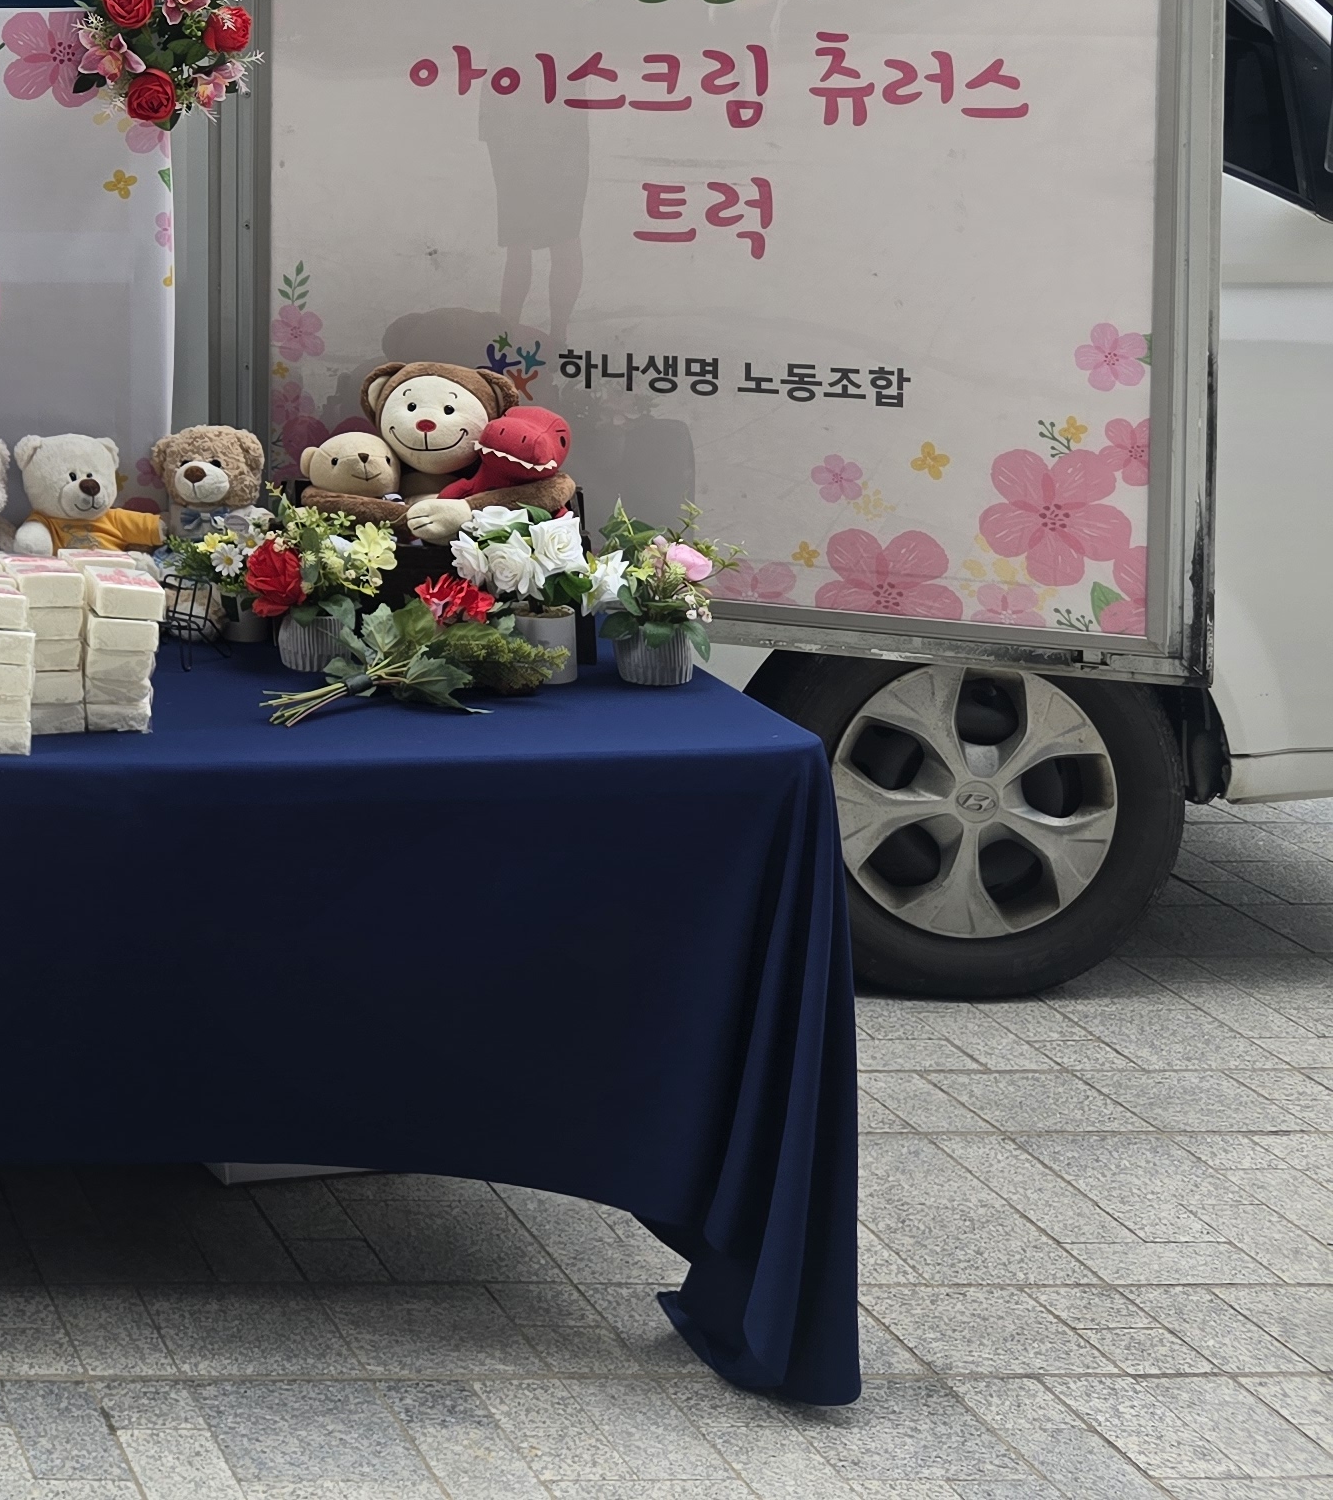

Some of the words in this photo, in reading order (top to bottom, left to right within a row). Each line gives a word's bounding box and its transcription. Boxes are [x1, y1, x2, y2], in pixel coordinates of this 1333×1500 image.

[409, 43, 770, 129] 아이스크림
[808, 31, 1030, 127] 츄러스
[632, 176, 775, 260] 트럭
[557, 349, 721, 396] 하나생명
[736, 362, 912, 408] 노동조합
